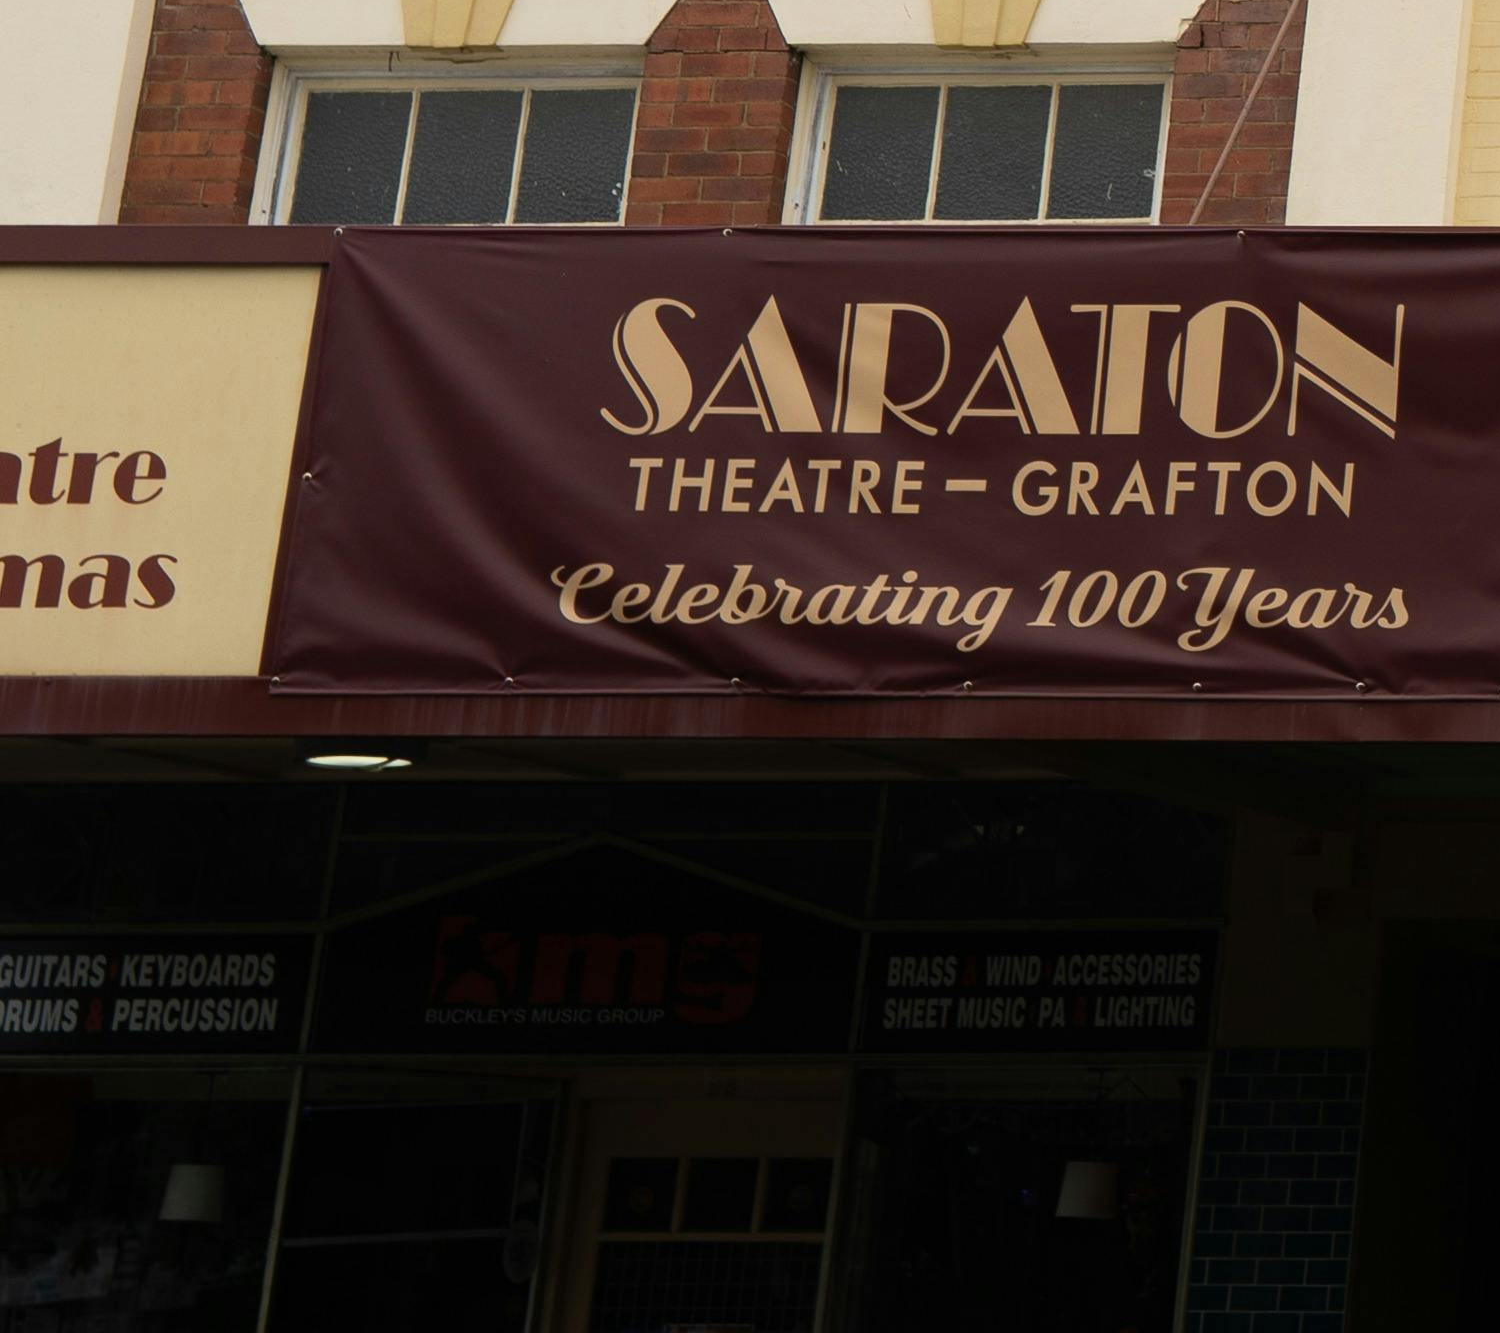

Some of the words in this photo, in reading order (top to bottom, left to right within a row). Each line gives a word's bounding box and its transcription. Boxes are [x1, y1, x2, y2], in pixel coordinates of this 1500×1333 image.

[600, 294, 1405, 440] SARATON
[629, 458, 925, 514] THEATRE
[1012, 460, 1356, 518] GRAFTON
[551, 563, 1014, 652] Celebrating
[1026, 570, 1167, 628] 100
[1176, 567, 1409, 653] Years
[0, 954, 109, 988] GUITARS
[120, 953, 276, 988] KEYBOARDS
[886, 955, 958, 987] BRASS
[986, 955, 1043, 987] WIND
[1052, 953, 1202, 986] ACCESSORIES
[84, 997, 104, 1032] &
[111, 997, 279, 1032] PERCUSSION
[424, 1007, 527, 1025] BUCKLEY'S
[531, 1007, 592, 1025] MUSIC
[596, 1007, 665, 1025] GROUP
[882, 997, 953, 1030] SHEET
[957, 997, 1026, 1029] MUSIC
[1038, 997, 1066, 1029] PA
[1094, 996, 1198, 1028] LIGHTING
